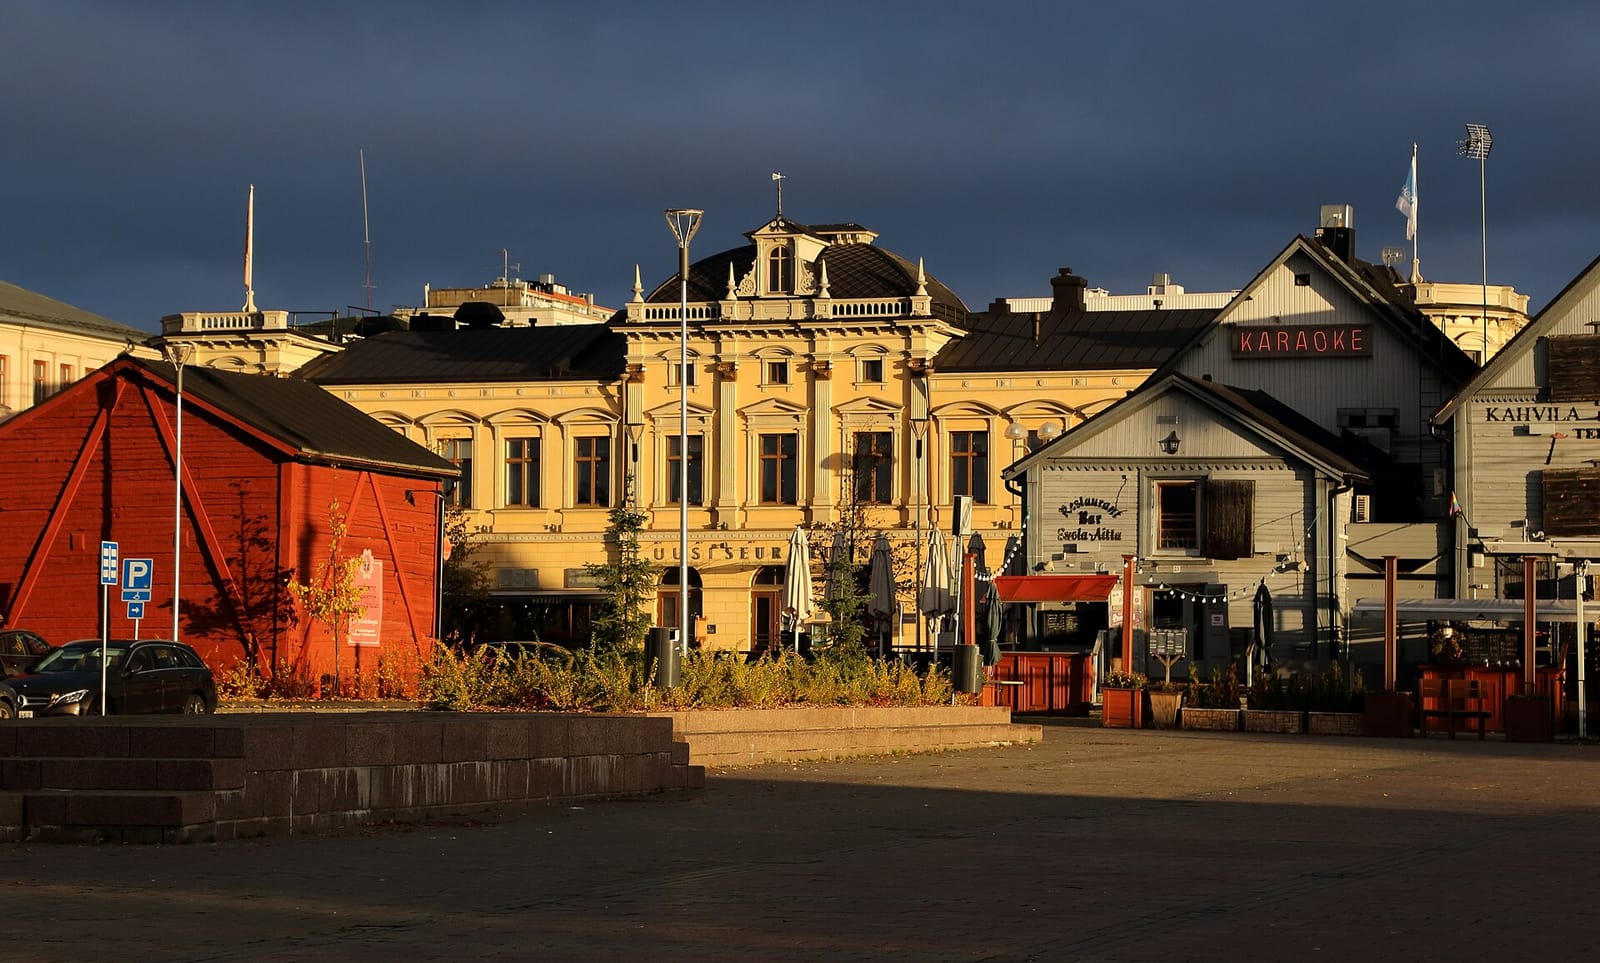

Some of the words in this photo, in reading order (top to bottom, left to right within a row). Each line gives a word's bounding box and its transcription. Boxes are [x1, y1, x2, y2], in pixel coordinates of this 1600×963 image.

[1240, 329, 1363, 352] KARAOKE
[1486, 406, 1580, 422] KAHVILA
[1572, 428, 1600, 439] TE
[1078, 510, 1102, 525] Bar
[128, 561, 148, 588] P
